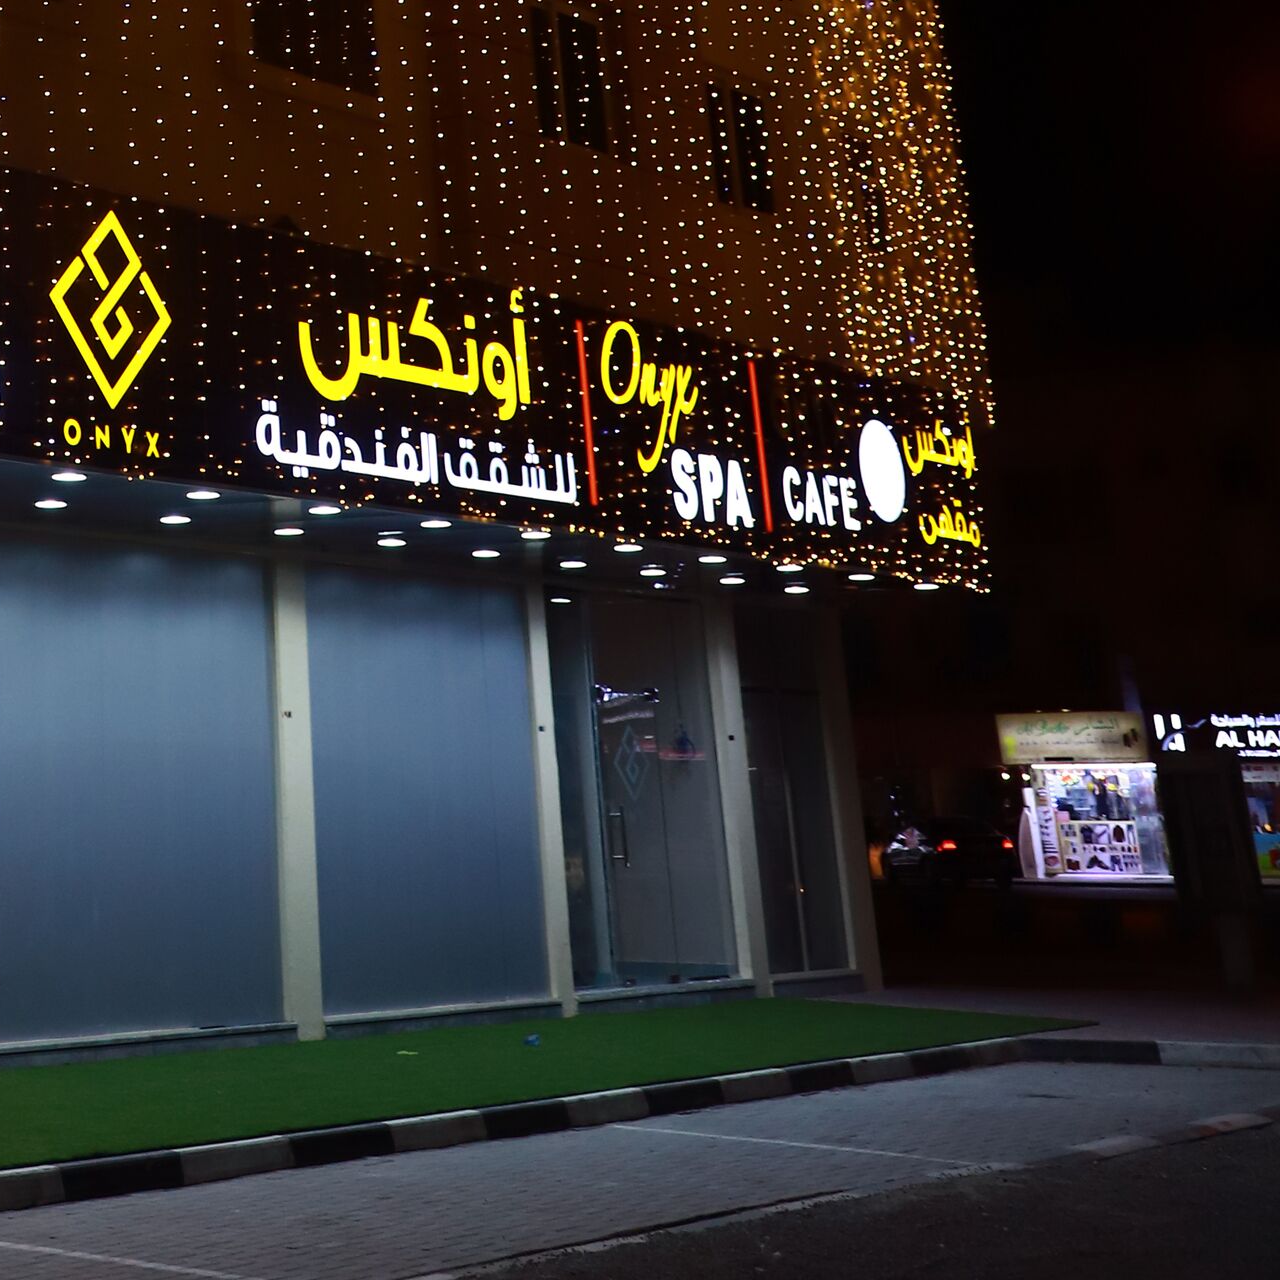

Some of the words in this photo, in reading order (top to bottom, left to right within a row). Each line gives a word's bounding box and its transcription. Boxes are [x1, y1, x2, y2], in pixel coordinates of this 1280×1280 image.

[297, 288, 531, 422] أونكس
[601, 321, 699, 473] Onyx
[63, 418, 160, 459] ONYX
[255, 399, 439, 485] الفندقية
[443, 437, 578, 504] للشقق
[902, 410, 976, 480] أونكس
[670, 448, 755, 529] SPA
[782, 465, 862, 532] CAFE
[1215, 730, 1246, 749] AL
[1247, 729, 1280, 748] HA
